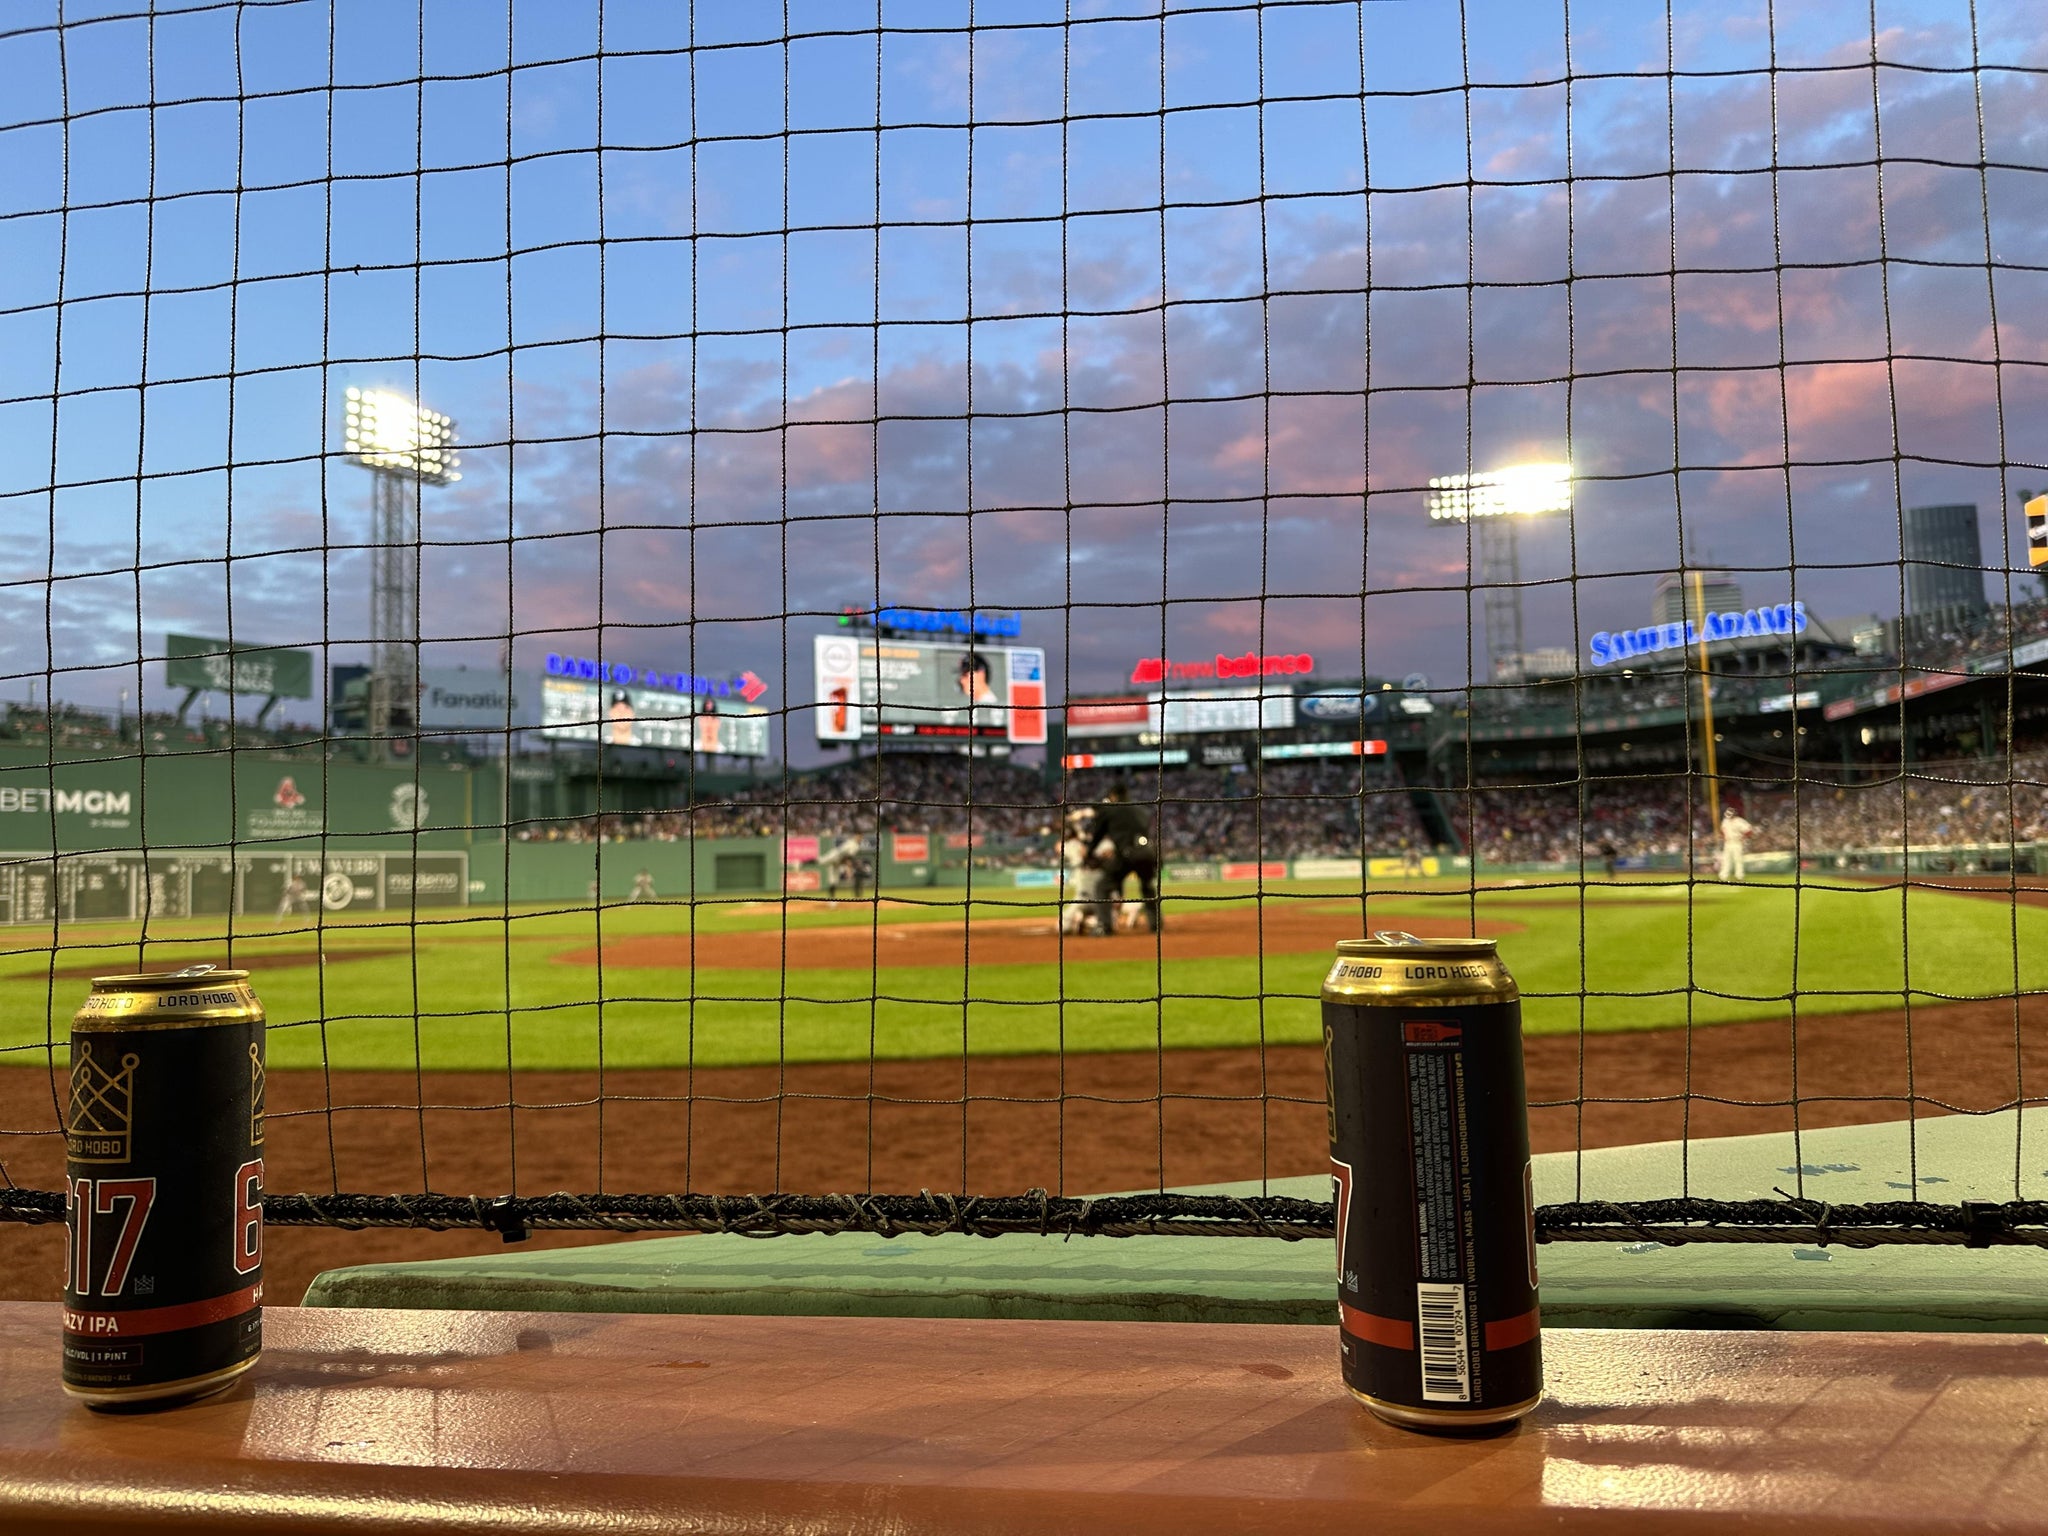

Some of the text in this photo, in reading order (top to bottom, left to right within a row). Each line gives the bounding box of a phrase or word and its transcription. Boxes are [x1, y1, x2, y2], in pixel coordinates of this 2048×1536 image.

[1590, 601, 1808, 666] SAMUEL ADAMS
[546, 652, 610, 682] BANK
[432, 687, 519, 709] Fanatics
[0, 787, 131, 815] BETMGM
[1348, 966, 1382, 978] HOBO
[1405, 964, 1487, 979] LORD HOBO
[100, 998, 134, 1009] HOO
[158, 992, 236, 1008] LORD HOBO
[85, 1140, 121, 1154] HOBO
[1464, 1210, 1473, 1236] MASS
[1420, 1236, 1430, 1278] GOVERNMENT
[1466, 1238, 1476, 1282] WOBURN,
[64, 1312, 119, 1332] AZY IPA
[1455, 1310, 1464, 1336] 00724
[1470, 1305, 1479, 1347] BREWING
[104, 1352, 128, 1361] PINT
[1457, 1349, 1466, 1376] 56544
[1472, 1350, 1481, 1376] HOBO
[1474, 1378, 1482, 1403] LORD
